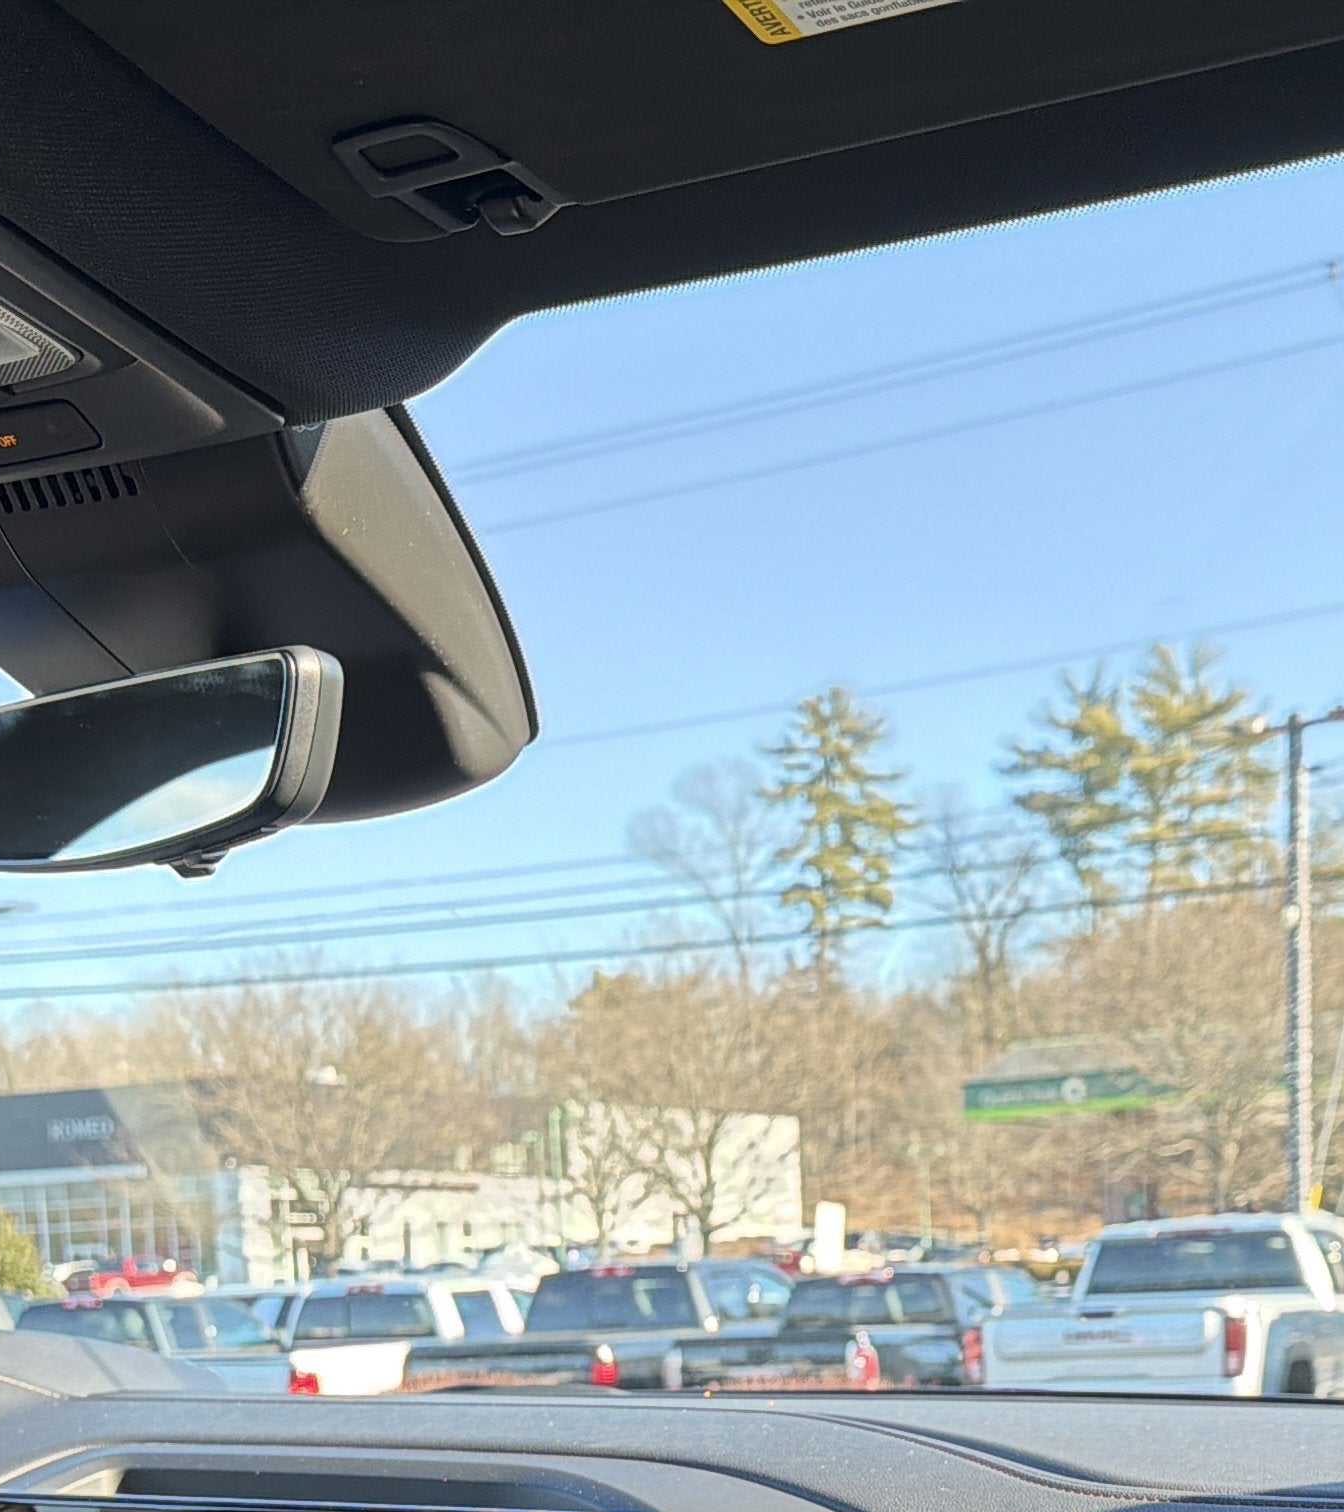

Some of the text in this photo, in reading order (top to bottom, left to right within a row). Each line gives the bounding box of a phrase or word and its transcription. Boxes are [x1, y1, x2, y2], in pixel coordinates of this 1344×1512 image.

[739, 0, 792, 37] AVERT
[806, 5, 832, 19] Voir
[816, 10, 869, 28] des sacs
